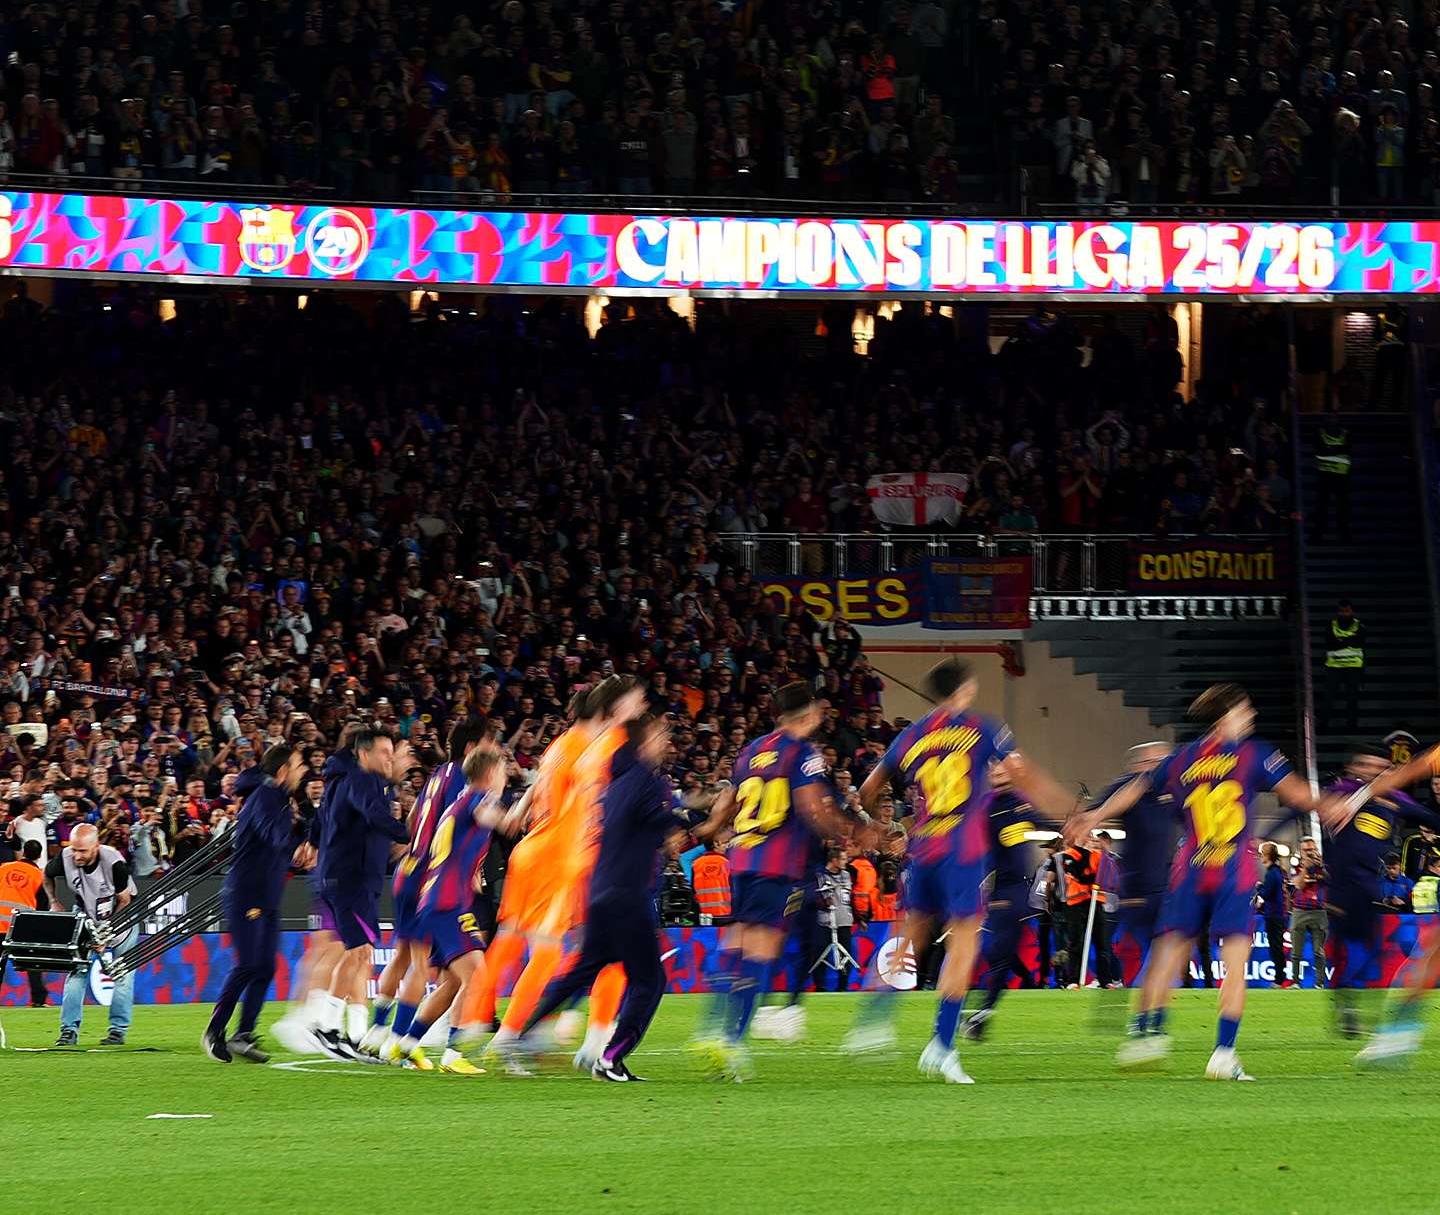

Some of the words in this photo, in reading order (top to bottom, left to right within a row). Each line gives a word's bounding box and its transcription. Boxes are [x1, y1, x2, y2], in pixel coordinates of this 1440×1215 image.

[615, 219, 922, 285] CAMPIONS
[930, 223, 997, 286] DE
[1006, 225, 1165, 287] LLIGA
[1172, 225, 1335, 287] 25/26
[1138, 546, 1276, 581] CONSTANTÍ
